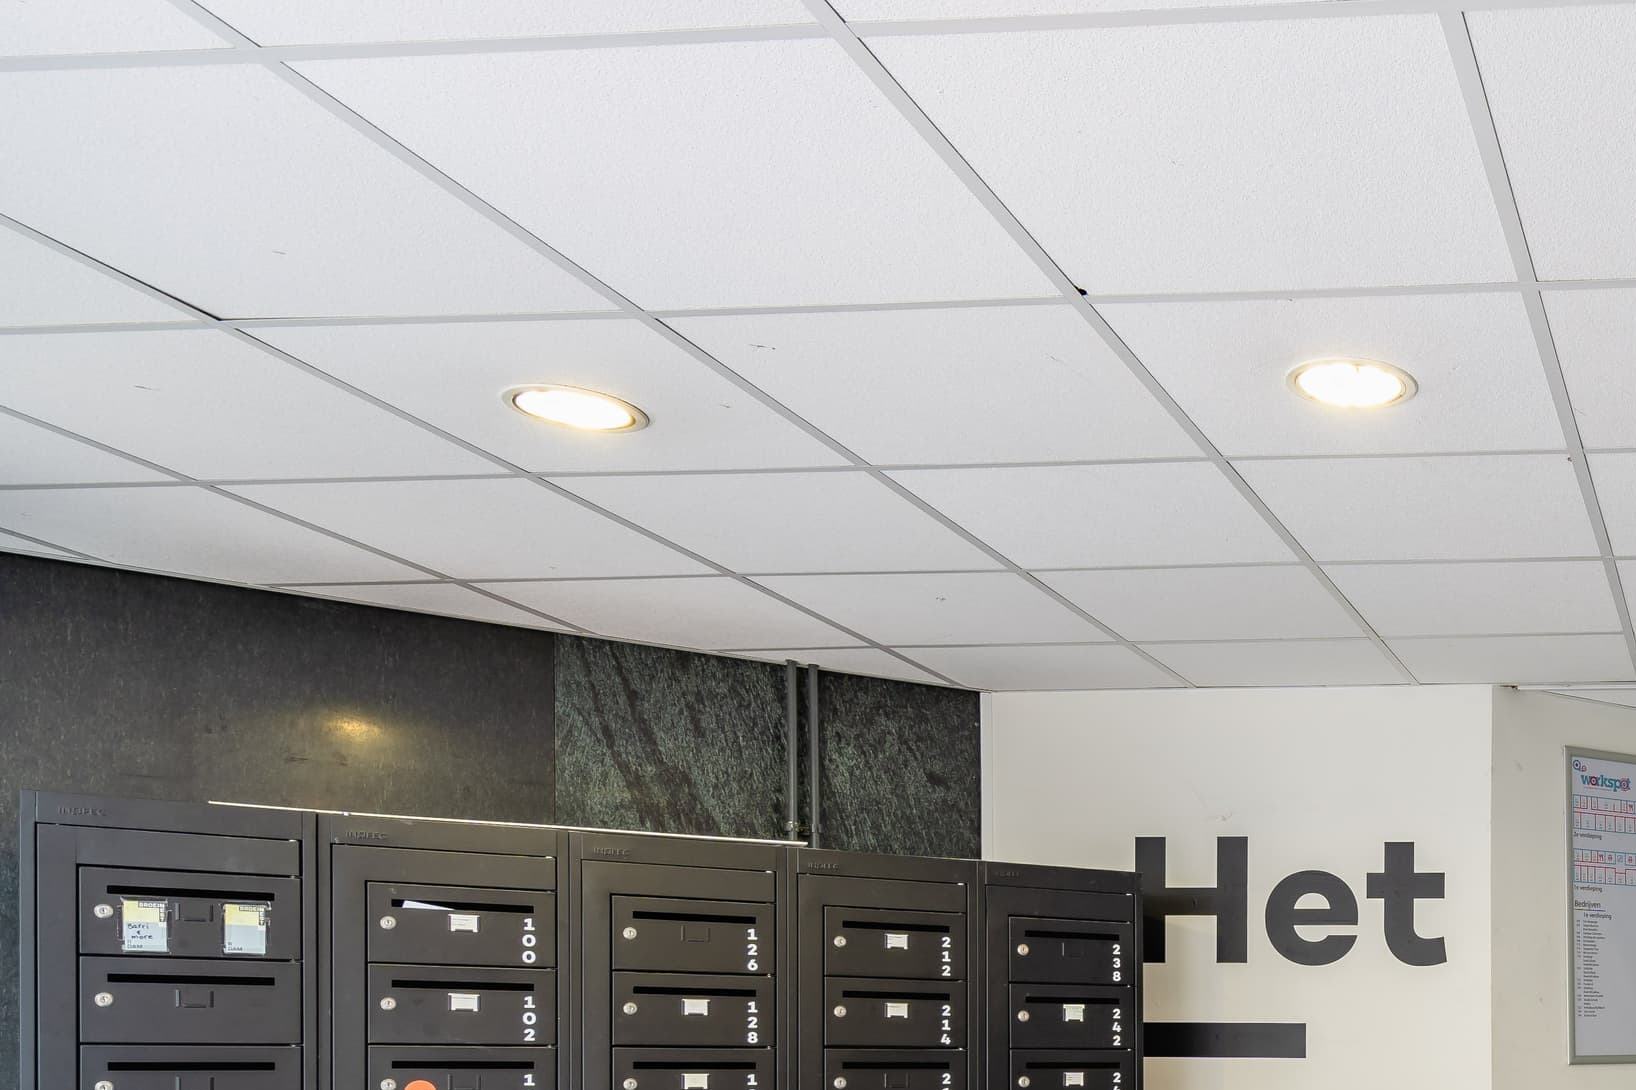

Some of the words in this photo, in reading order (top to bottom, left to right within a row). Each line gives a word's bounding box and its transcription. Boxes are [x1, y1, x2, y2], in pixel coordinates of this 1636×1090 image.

[1134, 836, 1448, 967] Het
[1574, 899, 1601, 909] Bedrijven
[521, 917, 537, 964] 100
[746, 928, 759, 972] 126
[941, 936, 952, 977] 212
[1112, 943, 1122, 982] 238
[522, 995, 537, 1042] 102
[746, 1000, 759, 1044] 128
[940, 1004, 952, 1045] 214
[1111, 1008, 1122, 1046] 242
